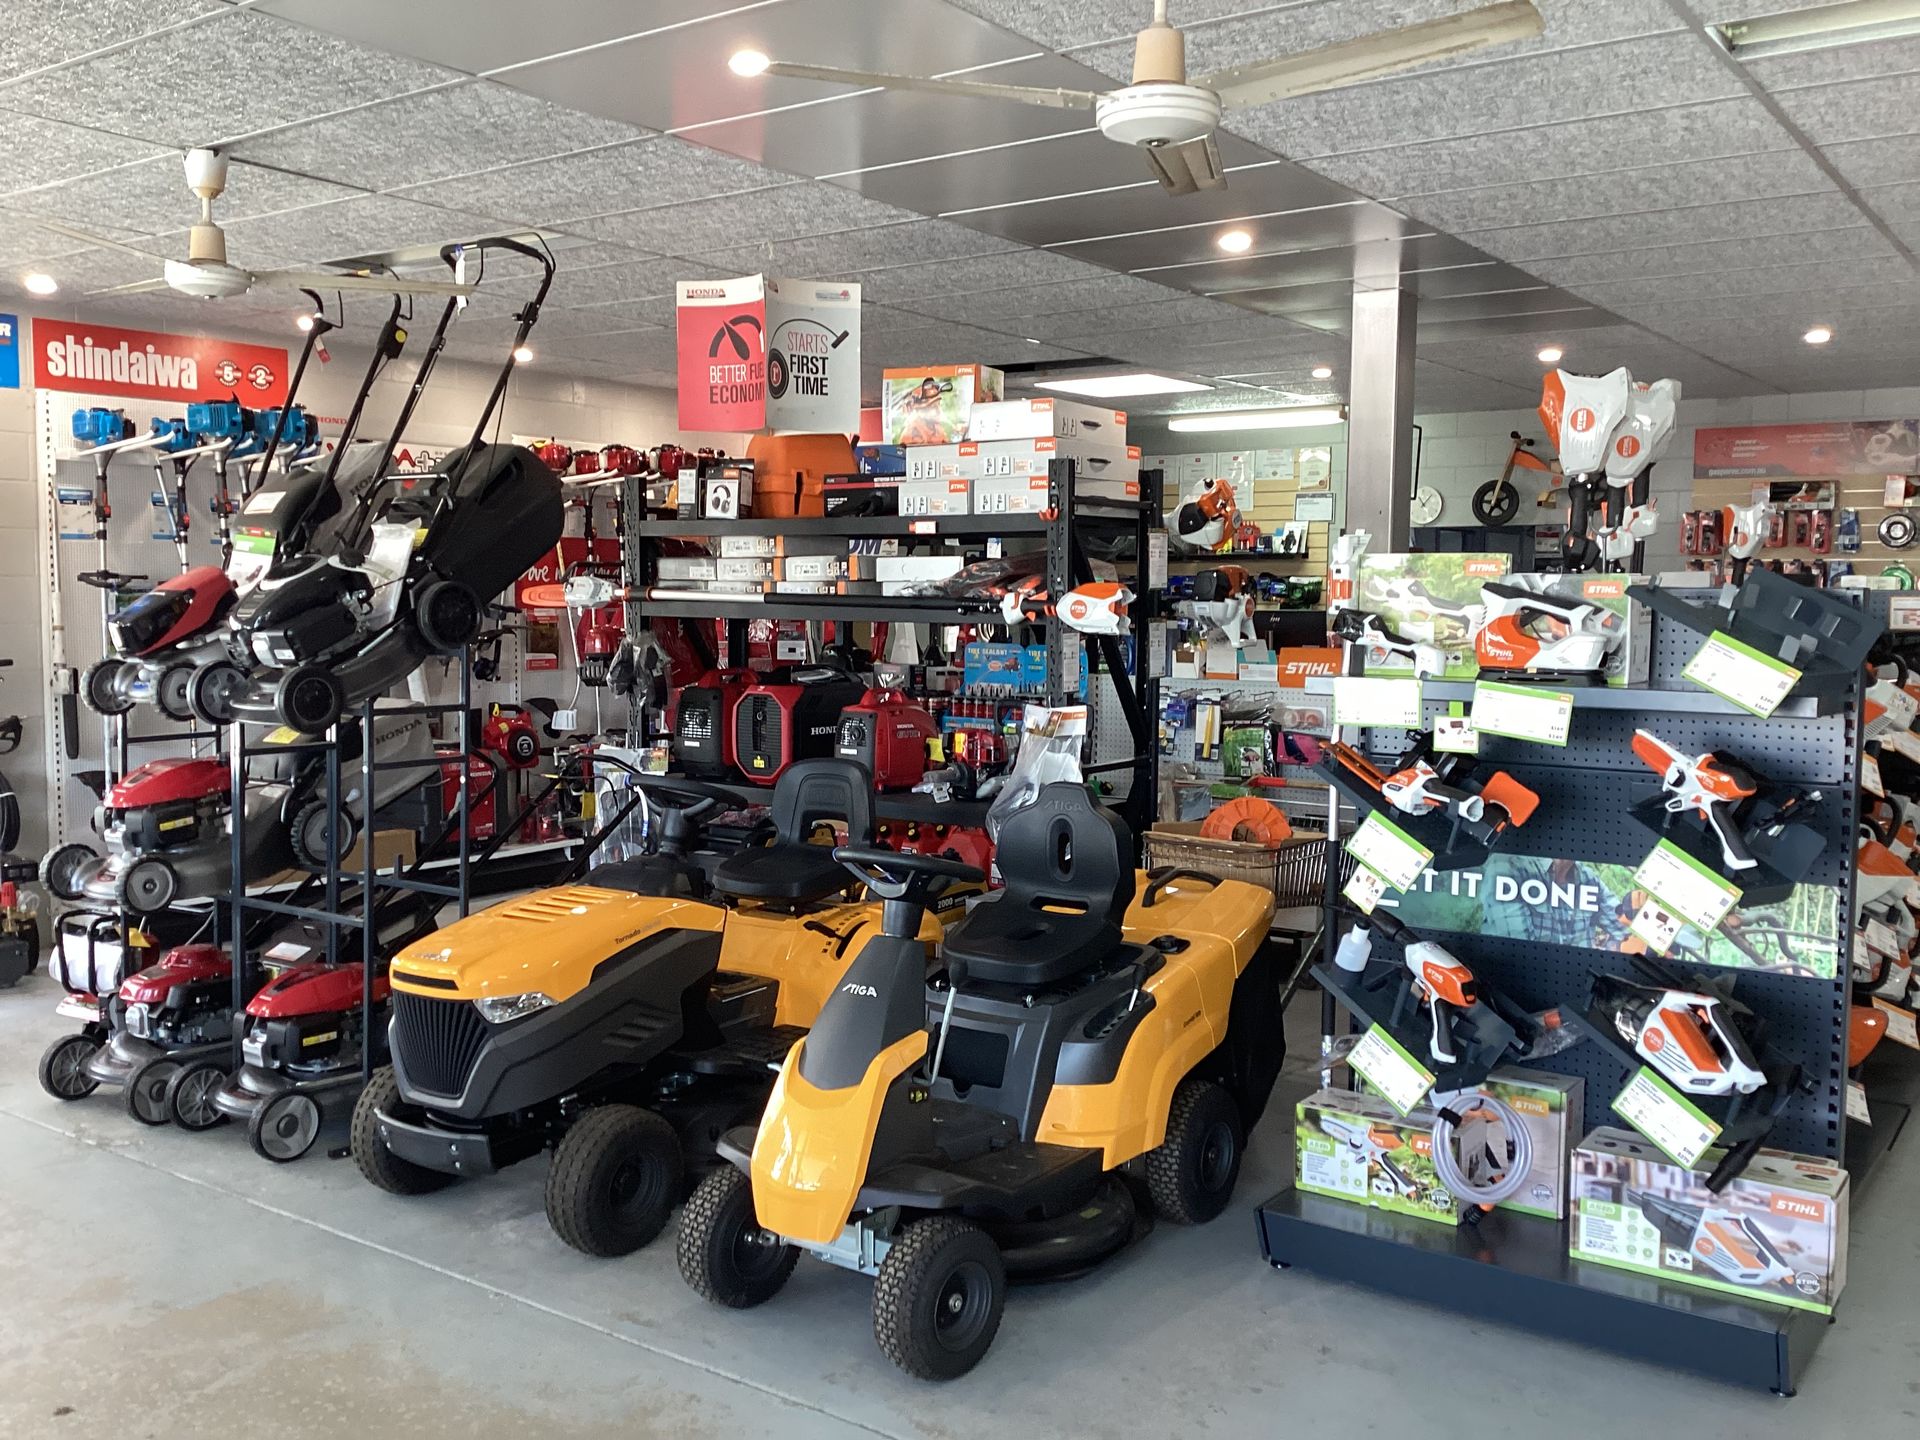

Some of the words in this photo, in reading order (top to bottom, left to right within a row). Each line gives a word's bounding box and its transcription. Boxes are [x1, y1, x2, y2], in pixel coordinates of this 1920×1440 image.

[788, 331, 828, 354] STARTS
[47, 335, 197, 390] shindaiwa
[790, 354, 828, 376] FIRST
[223, 366, 233, 381] 5
[256, 369, 266, 385] 2
[709, 364, 747, 384] BETTER
[750, 361, 764, 381] FUE
[957, 367, 973, 375] STIHL
[709, 382, 765, 404] ECONOM
[794, 375, 828, 397] TIME
[1032, 402, 1050, 411] STIHL
[317, 416, 349, 425] HOND
[960, 446, 977, 454] STIHL
[1036, 440, 1054, 449] STIHL
[950, 482, 966, 491] STIHL
[1031, 479, 1048, 488] STIHL
[518, 565, 551, 582] ove
[1469, 563, 1499, 573] STIHL
[1588, 585, 1619, 594] STIHL
[1489, 649, 1514, 658] STIHL
[1285, 662, 1334, 675] STIHL
[376, 719, 422, 745] HONDA
[1451, 871, 1482, 898] IT
[1495, 876, 1599, 912] DONE
[937, 897, 954, 910] 2000
[615, 929, 641, 944] Tornado
[842, 983, 877, 997] STIGA
[1515, 1101, 1544, 1113] STIHL
[1776, 1200, 1819, 1217] STIHL
